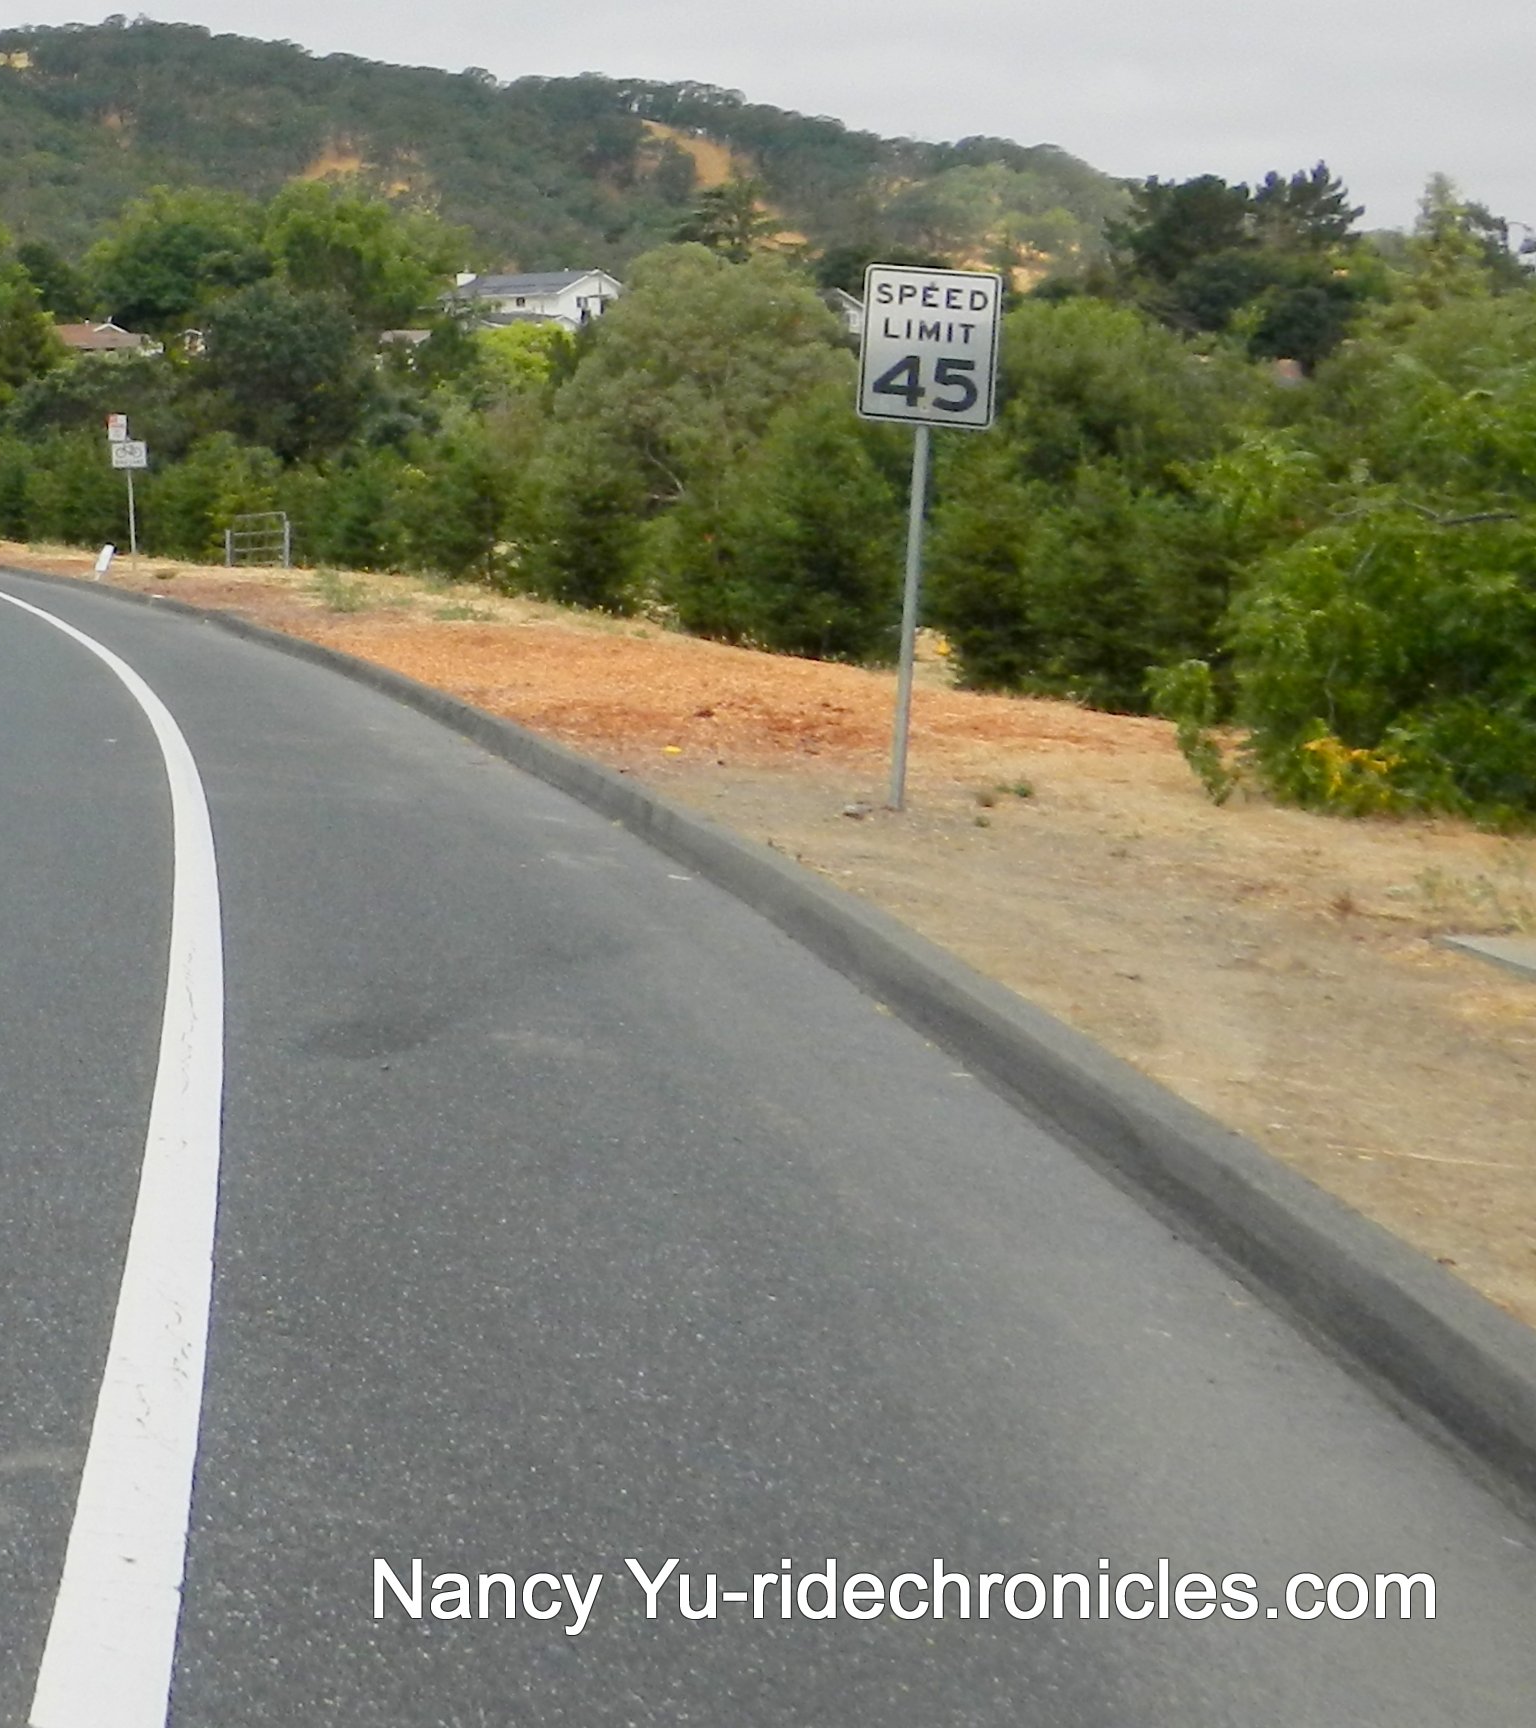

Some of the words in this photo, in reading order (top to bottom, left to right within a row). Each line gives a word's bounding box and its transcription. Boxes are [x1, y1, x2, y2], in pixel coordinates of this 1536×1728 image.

[876, 282, 988, 311] SPEED
[883, 317, 975, 344] LIMIT
[872, 355, 978, 412] 45
